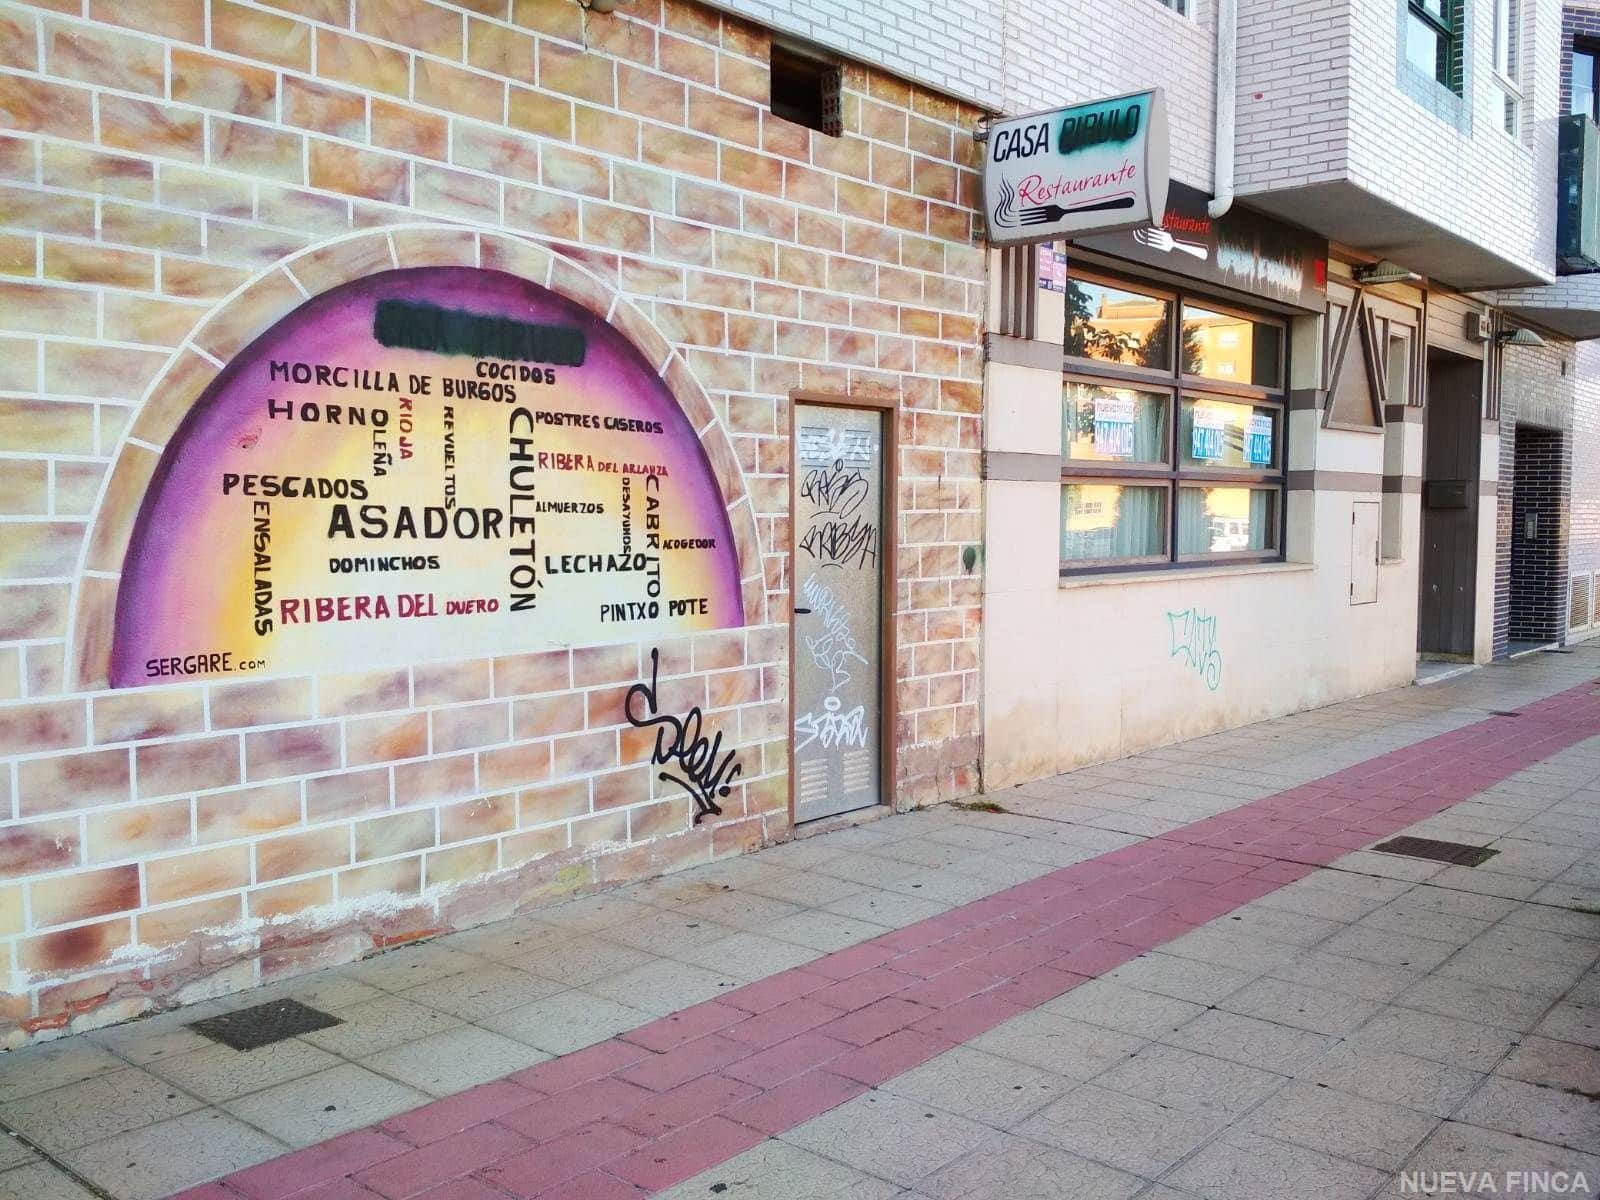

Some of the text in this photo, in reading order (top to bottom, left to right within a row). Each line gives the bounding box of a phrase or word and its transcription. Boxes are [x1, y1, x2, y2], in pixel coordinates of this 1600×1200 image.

[993, 122, 1049, 162] CASA
[1016, 159, 1136, 207] Restaurante
[270, 360, 517, 403] MORCILLA DE BURGOS
[476, 361, 556, 385] COCIDOS
[268, 399, 389, 426] HORNO
[535, 411, 664, 434] POSTRES CASEROS
[399, 397, 413, 460] RIOJA
[372, 429, 392, 477] LEÑA
[443, 406, 456, 510] REVUELTOS
[538, 452, 669, 477] RIBERA DEL ARLANZA
[223, 473, 369, 500] PESCADOS
[328, 504, 503, 539] ASADOR
[509, 407, 543, 612] CHULETÓN
[535, 501, 604, 514] ALMUERZOS
[646, 475, 661, 597] CABRITO
[663, 539, 716, 550] ACOGEDOR
[253, 500, 273, 636] ENSALADAS
[329, 556, 440, 573] DOMINCHOS
[545, 553, 647, 574] LECHAZO
[280, 594, 499, 624] RIBERA DEL DUERO
[600, 598, 709, 622] PINTXO POTE
